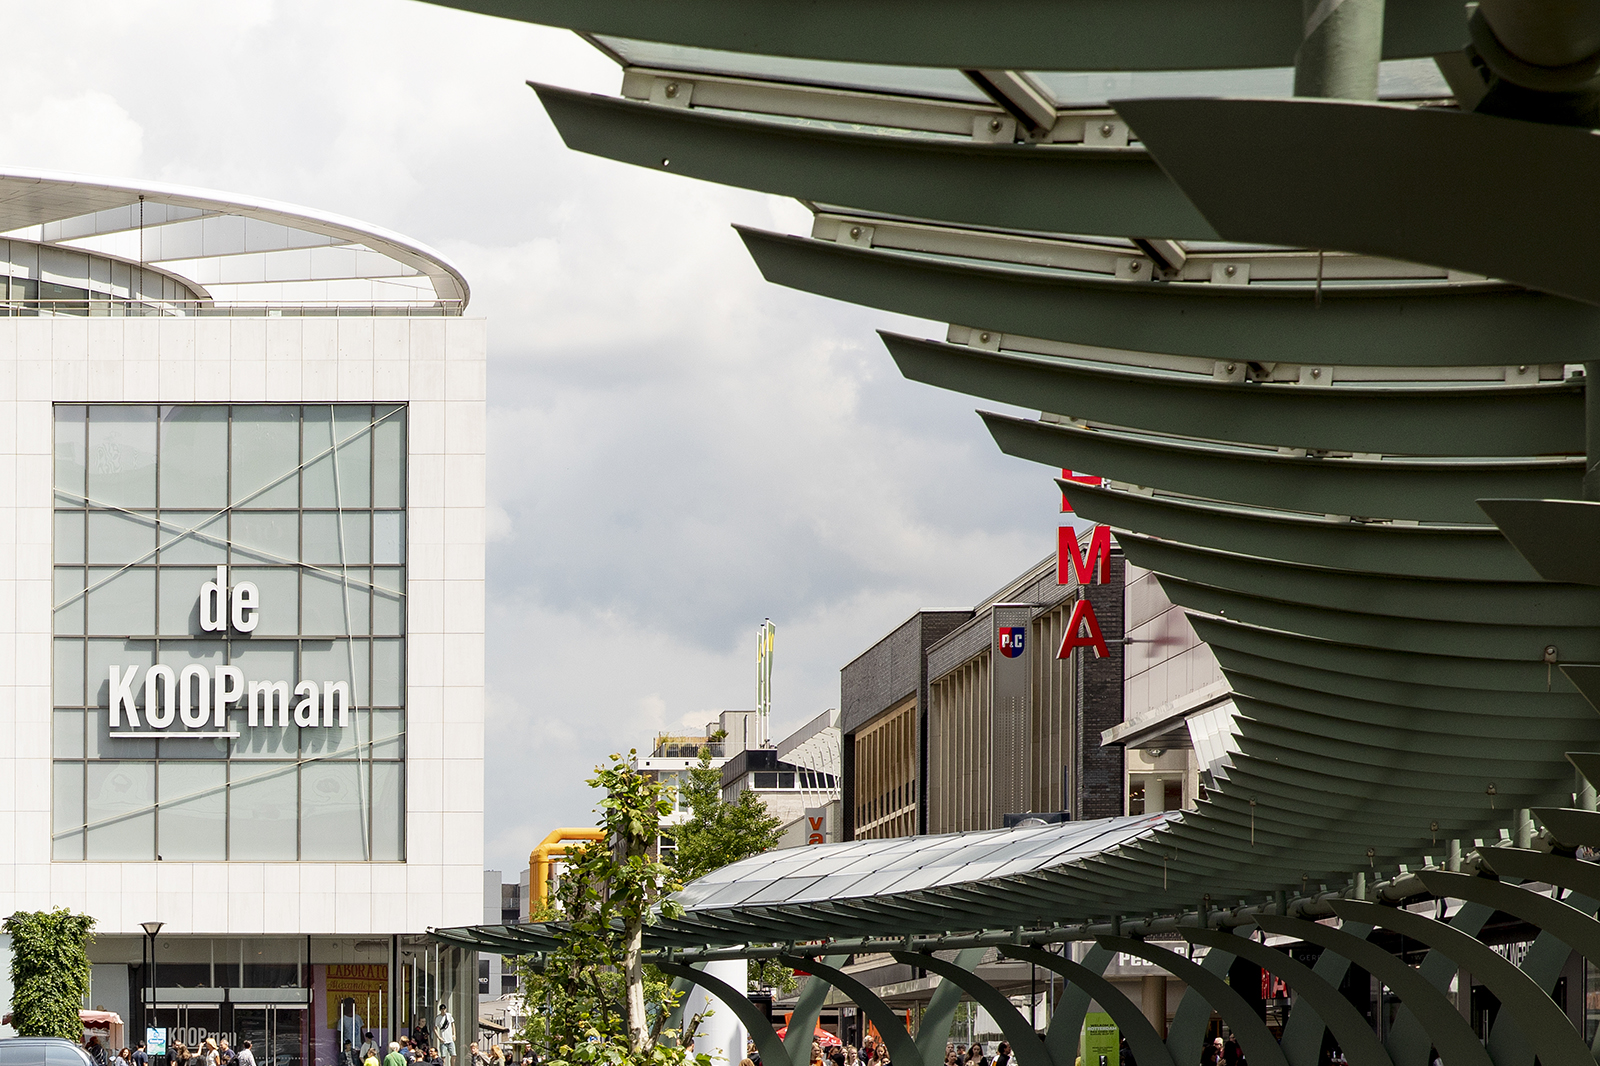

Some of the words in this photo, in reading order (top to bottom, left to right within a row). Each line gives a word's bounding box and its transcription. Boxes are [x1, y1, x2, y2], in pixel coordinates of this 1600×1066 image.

[199, 565, 260, 633] de
[1001, 633, 1023, 648] P&C
[108, 665, 350, 729] KOOPman
[327, 964, 389, 978] LABORATO
